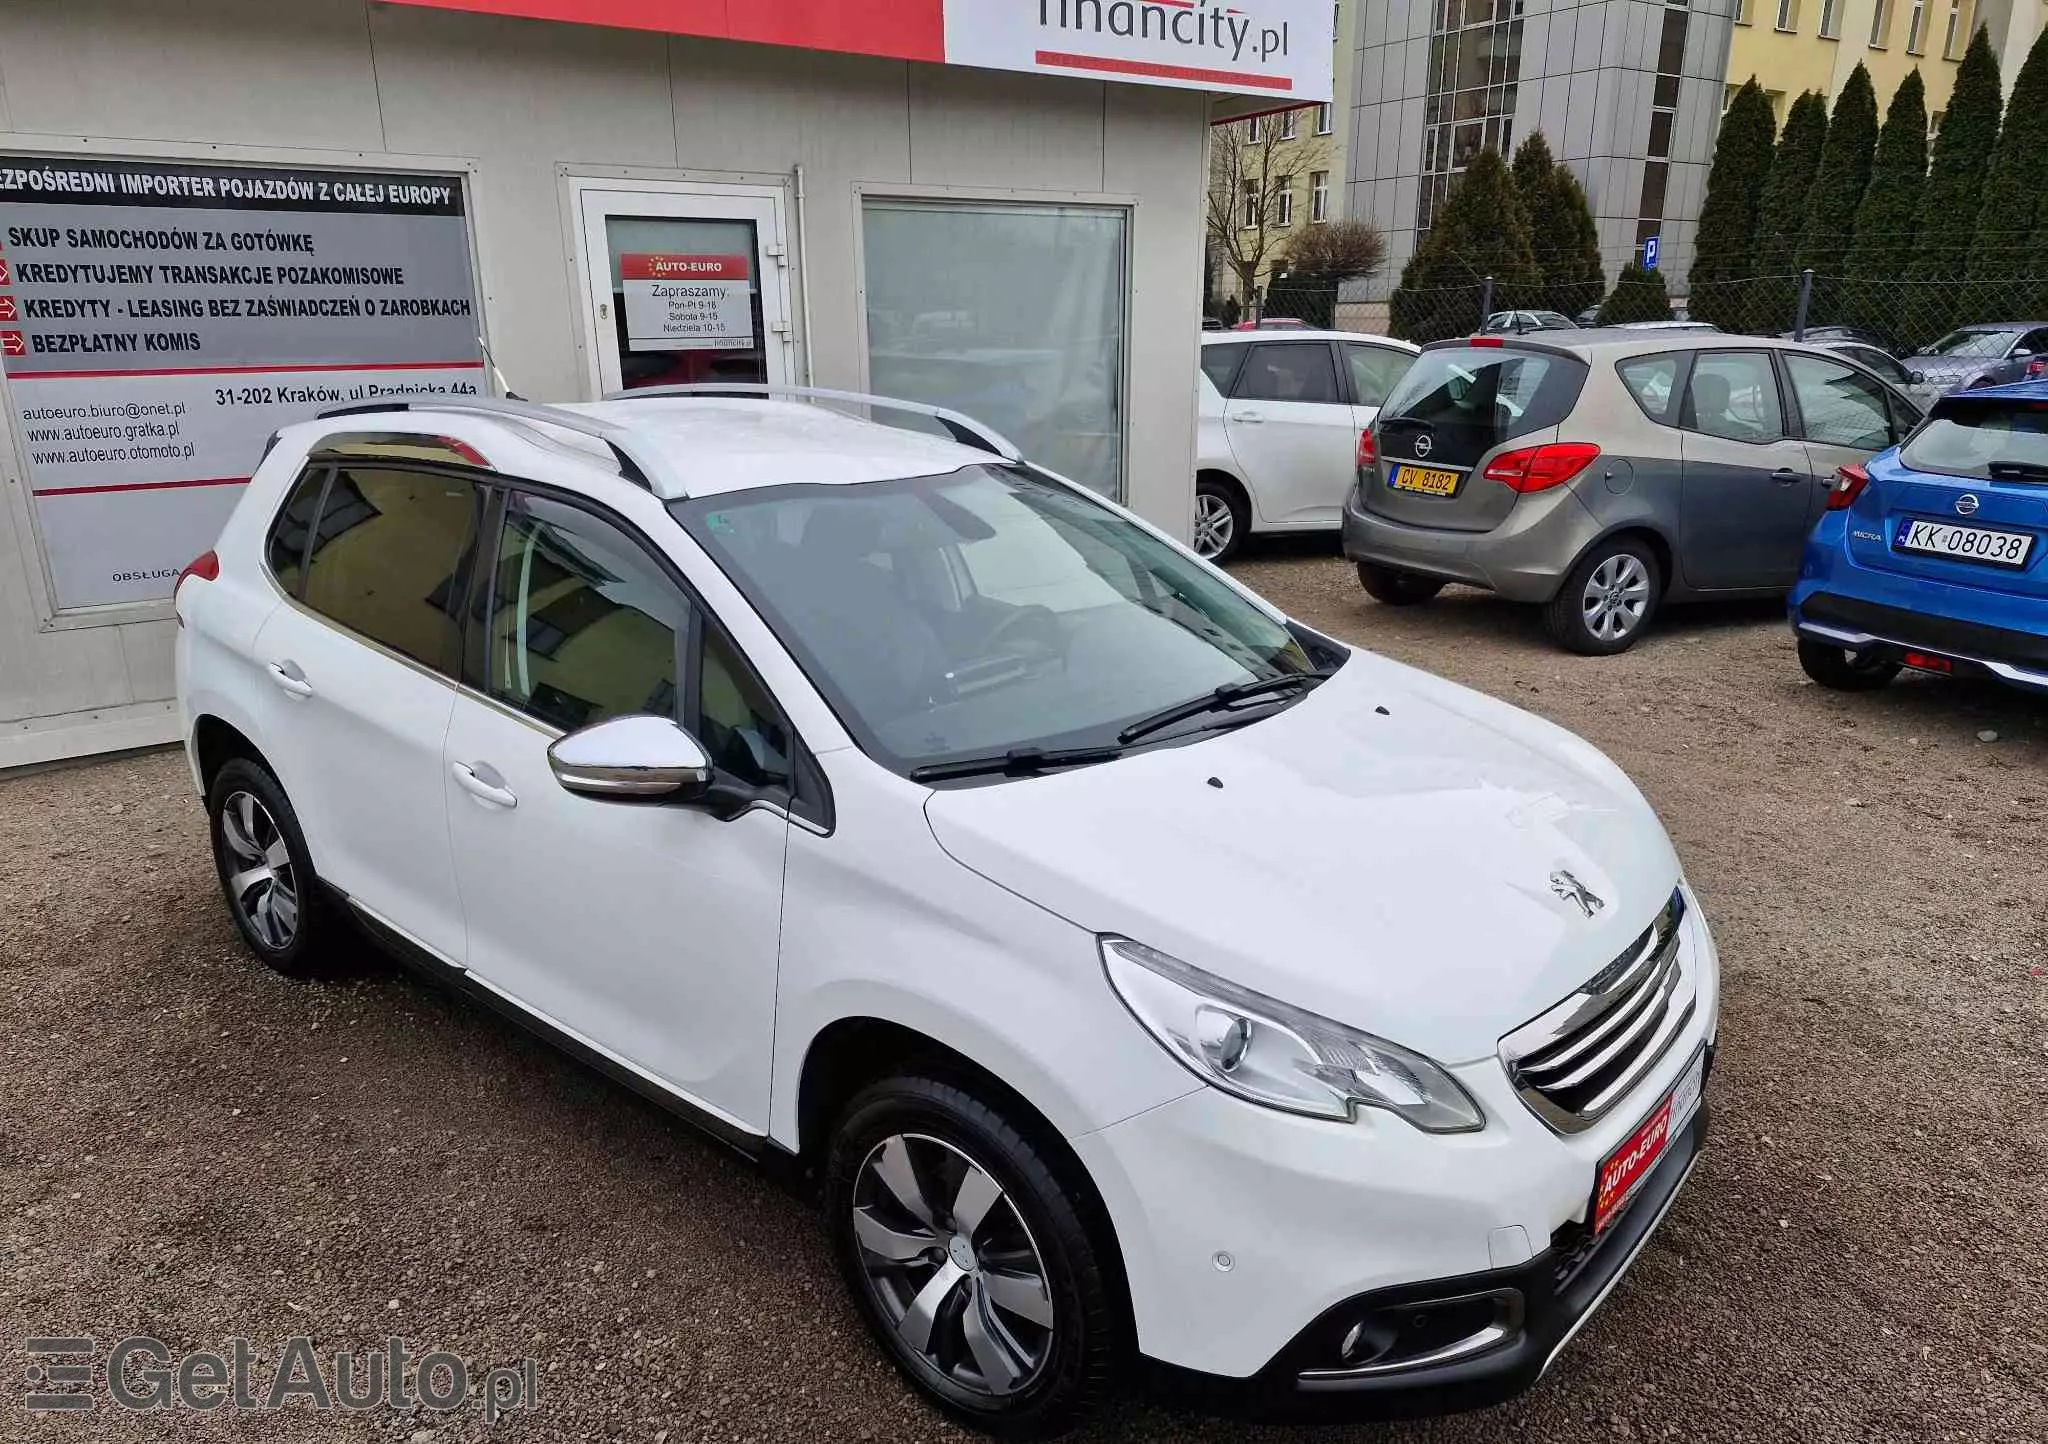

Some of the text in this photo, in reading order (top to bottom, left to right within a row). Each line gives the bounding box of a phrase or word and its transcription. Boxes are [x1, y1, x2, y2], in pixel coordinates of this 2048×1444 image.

[120, 173, 217, 198] IMPORTER
[219, 175, 315, 201] POJAZDÓW
[318, 181, 331, 201] Z
[333, 181, 385, 203] CAŁEJ
[388, 184, 451, 205] EUROPY
[8, 226, 315, 256] SKUP SAMOCHODÓW ZA GOTÓWKĘ
[1646, 240, 1656, 264] P
[16, 263, 404, 286] KREDYTUJEMY TRANSAKCJE POZAKOMISOWE
[655, 261, 722, 273] AUTO-EURO
[24, 299, 113, 319] KREDYTY
[128, 299, 204, 319] LEASING
[208, 299, 243, 318] BEZ
[246, 294, 361, 318] ZAŚWIADCZEŃ
[365, 300, 377, 317] O
[380, 299, 471, 317] ZAROBKACH
[663, 323, 701, 333] Niedziela
[31, 332, 201, 354] BEZPŁATNY KOMIS
[215, 386, 273, 407] 31-202
[23, 401, 186, 422] autoeuro.biuro@onet.pl
[27, 421, 180, 443] www.autoeuro.gratka.pl
[31, 441, 196, 466] www.autoeuro.otomoto.pl
[1401, 469, 1452, 491] CV 8182
[1910, 524, 2023, 560] KK 08038
[112, 567, 181, 583] OBSŁUGA
[1603, 1114, 1668, 1196] AUTO-EURO
